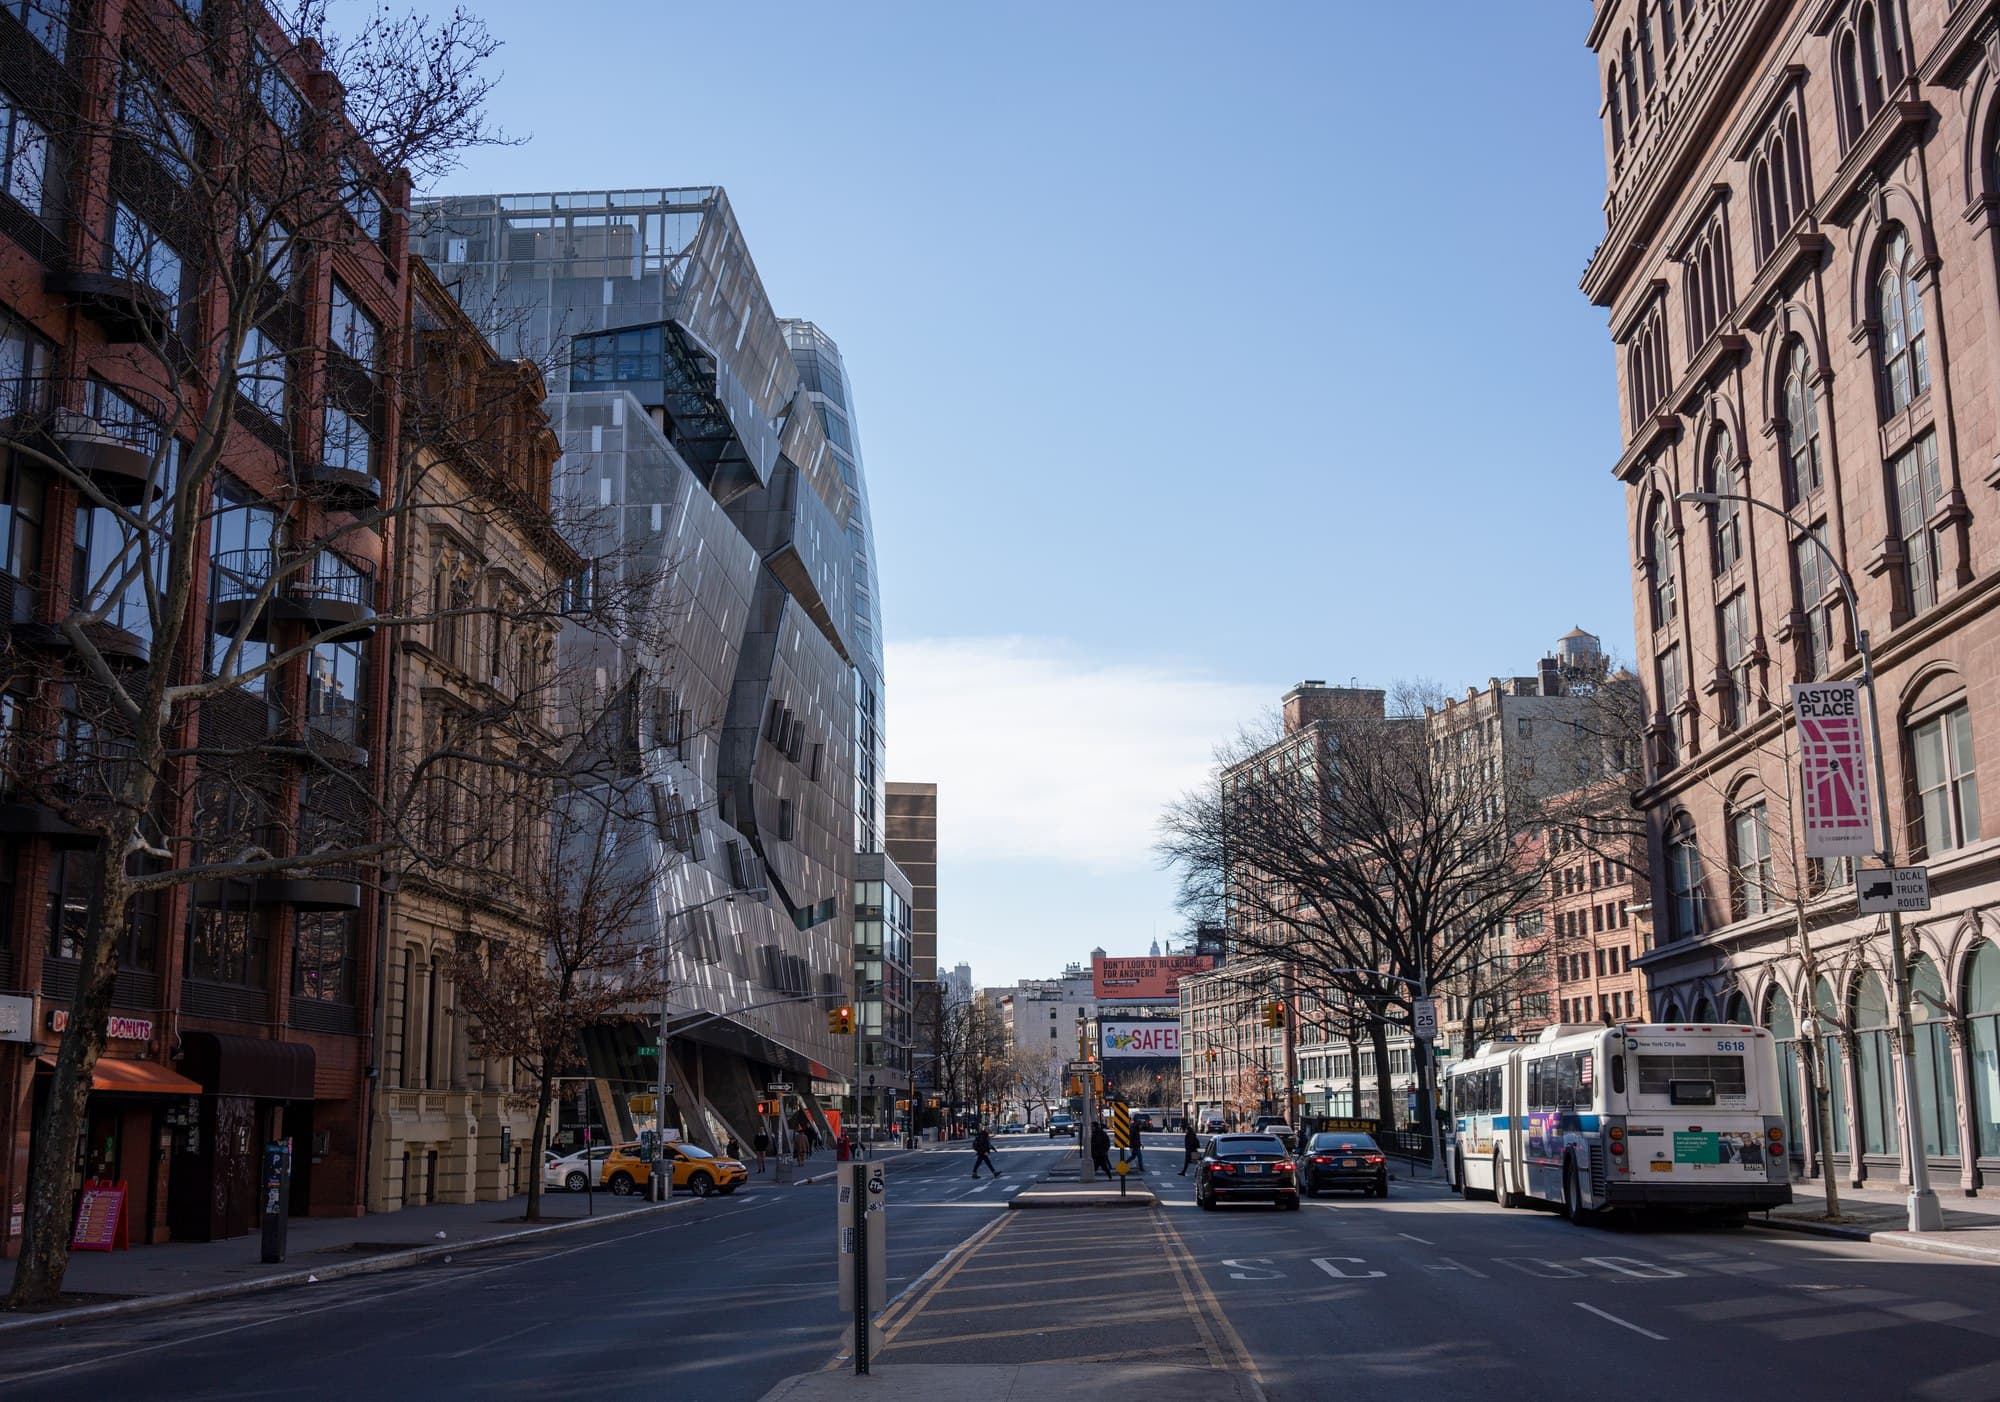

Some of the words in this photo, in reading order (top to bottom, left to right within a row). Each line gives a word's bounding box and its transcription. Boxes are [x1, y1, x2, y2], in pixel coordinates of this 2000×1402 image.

[1797, 688, 1856, 705] ASTOR
[1799, 702, 1855, 717] PLACE
[1894, 871, 1923, 881] LOCAL
[1896, 884, 1925, 894] TRUCK
[1897, 897, 1926, 907] ROUTE
[1103, 961, 1124, 970] DON'T
[1127, 960, 1146, 969] LOOK
[1148, 960, 1157, 969] TO
[1159, 959, 1204, 968] BILLBOARDS
[1103, 970, 1117, 978] FOR
[1119, 969, 1157, 978] ANSWERS!
[1417, 1015, 1434, 1026] 25
[110, 1016, 151, 1040] DONUTS
[1131, 1029, 1179, 1050] SAFE!
[1717, 1041, 1745, 1051] 5618
